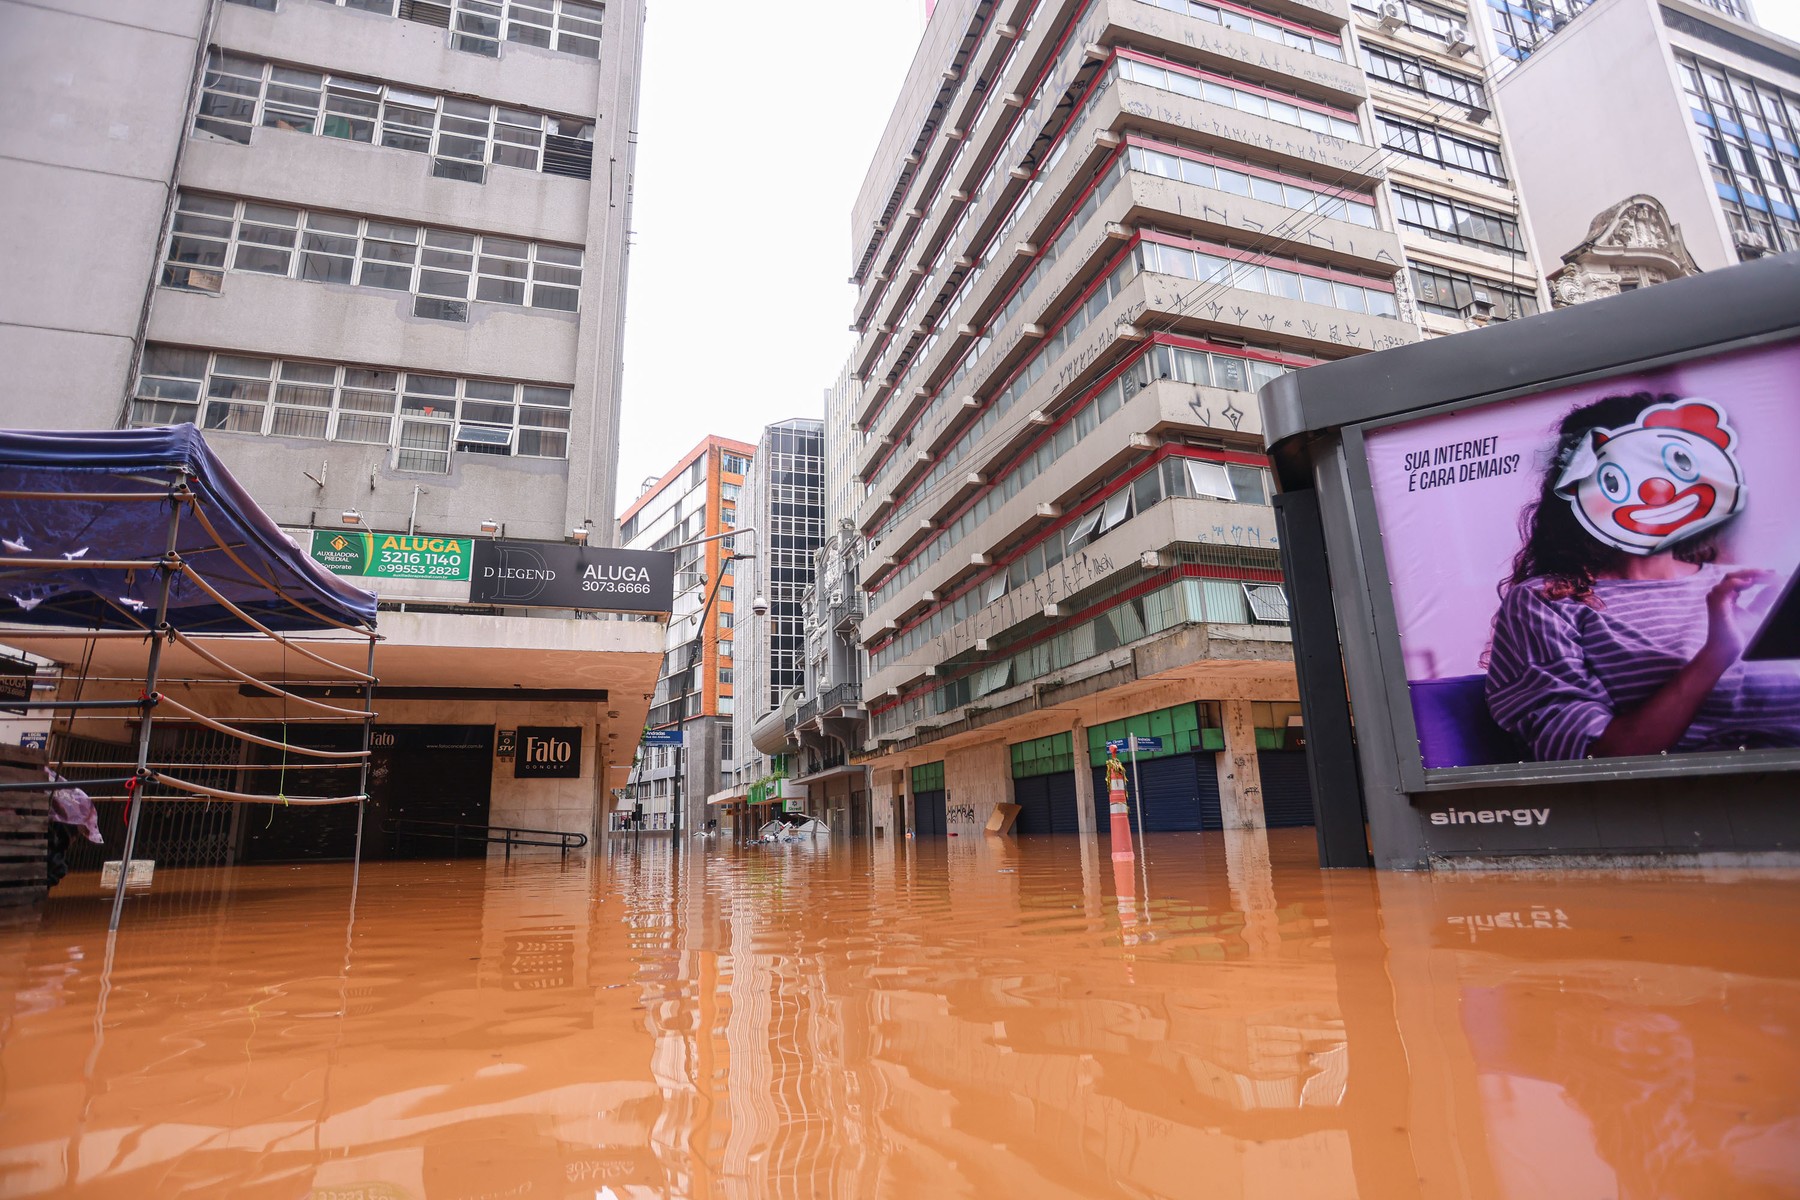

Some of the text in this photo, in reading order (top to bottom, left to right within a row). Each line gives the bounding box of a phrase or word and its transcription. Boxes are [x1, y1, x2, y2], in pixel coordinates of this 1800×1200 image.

[1404, 435, 1498, 471] SUA INTERNET
[1408, 453, 1520, 492] É CARA DEMAIS?
[381, 535, 461, 554] ALUGA
[381, 551, 461, 566] 3216 1140
[387, 564, 460, 576] 99553 2828
[484, 567, 556, 581] D LEGEND
[583, 564, 650, 582] ALUGA
[582, 581, 651, 594] 3073.6666
[369, 732, 394, 746] Fato
[526, 736, 571, 763] Fato
[1430, 807, 1550, 826] sinergy
